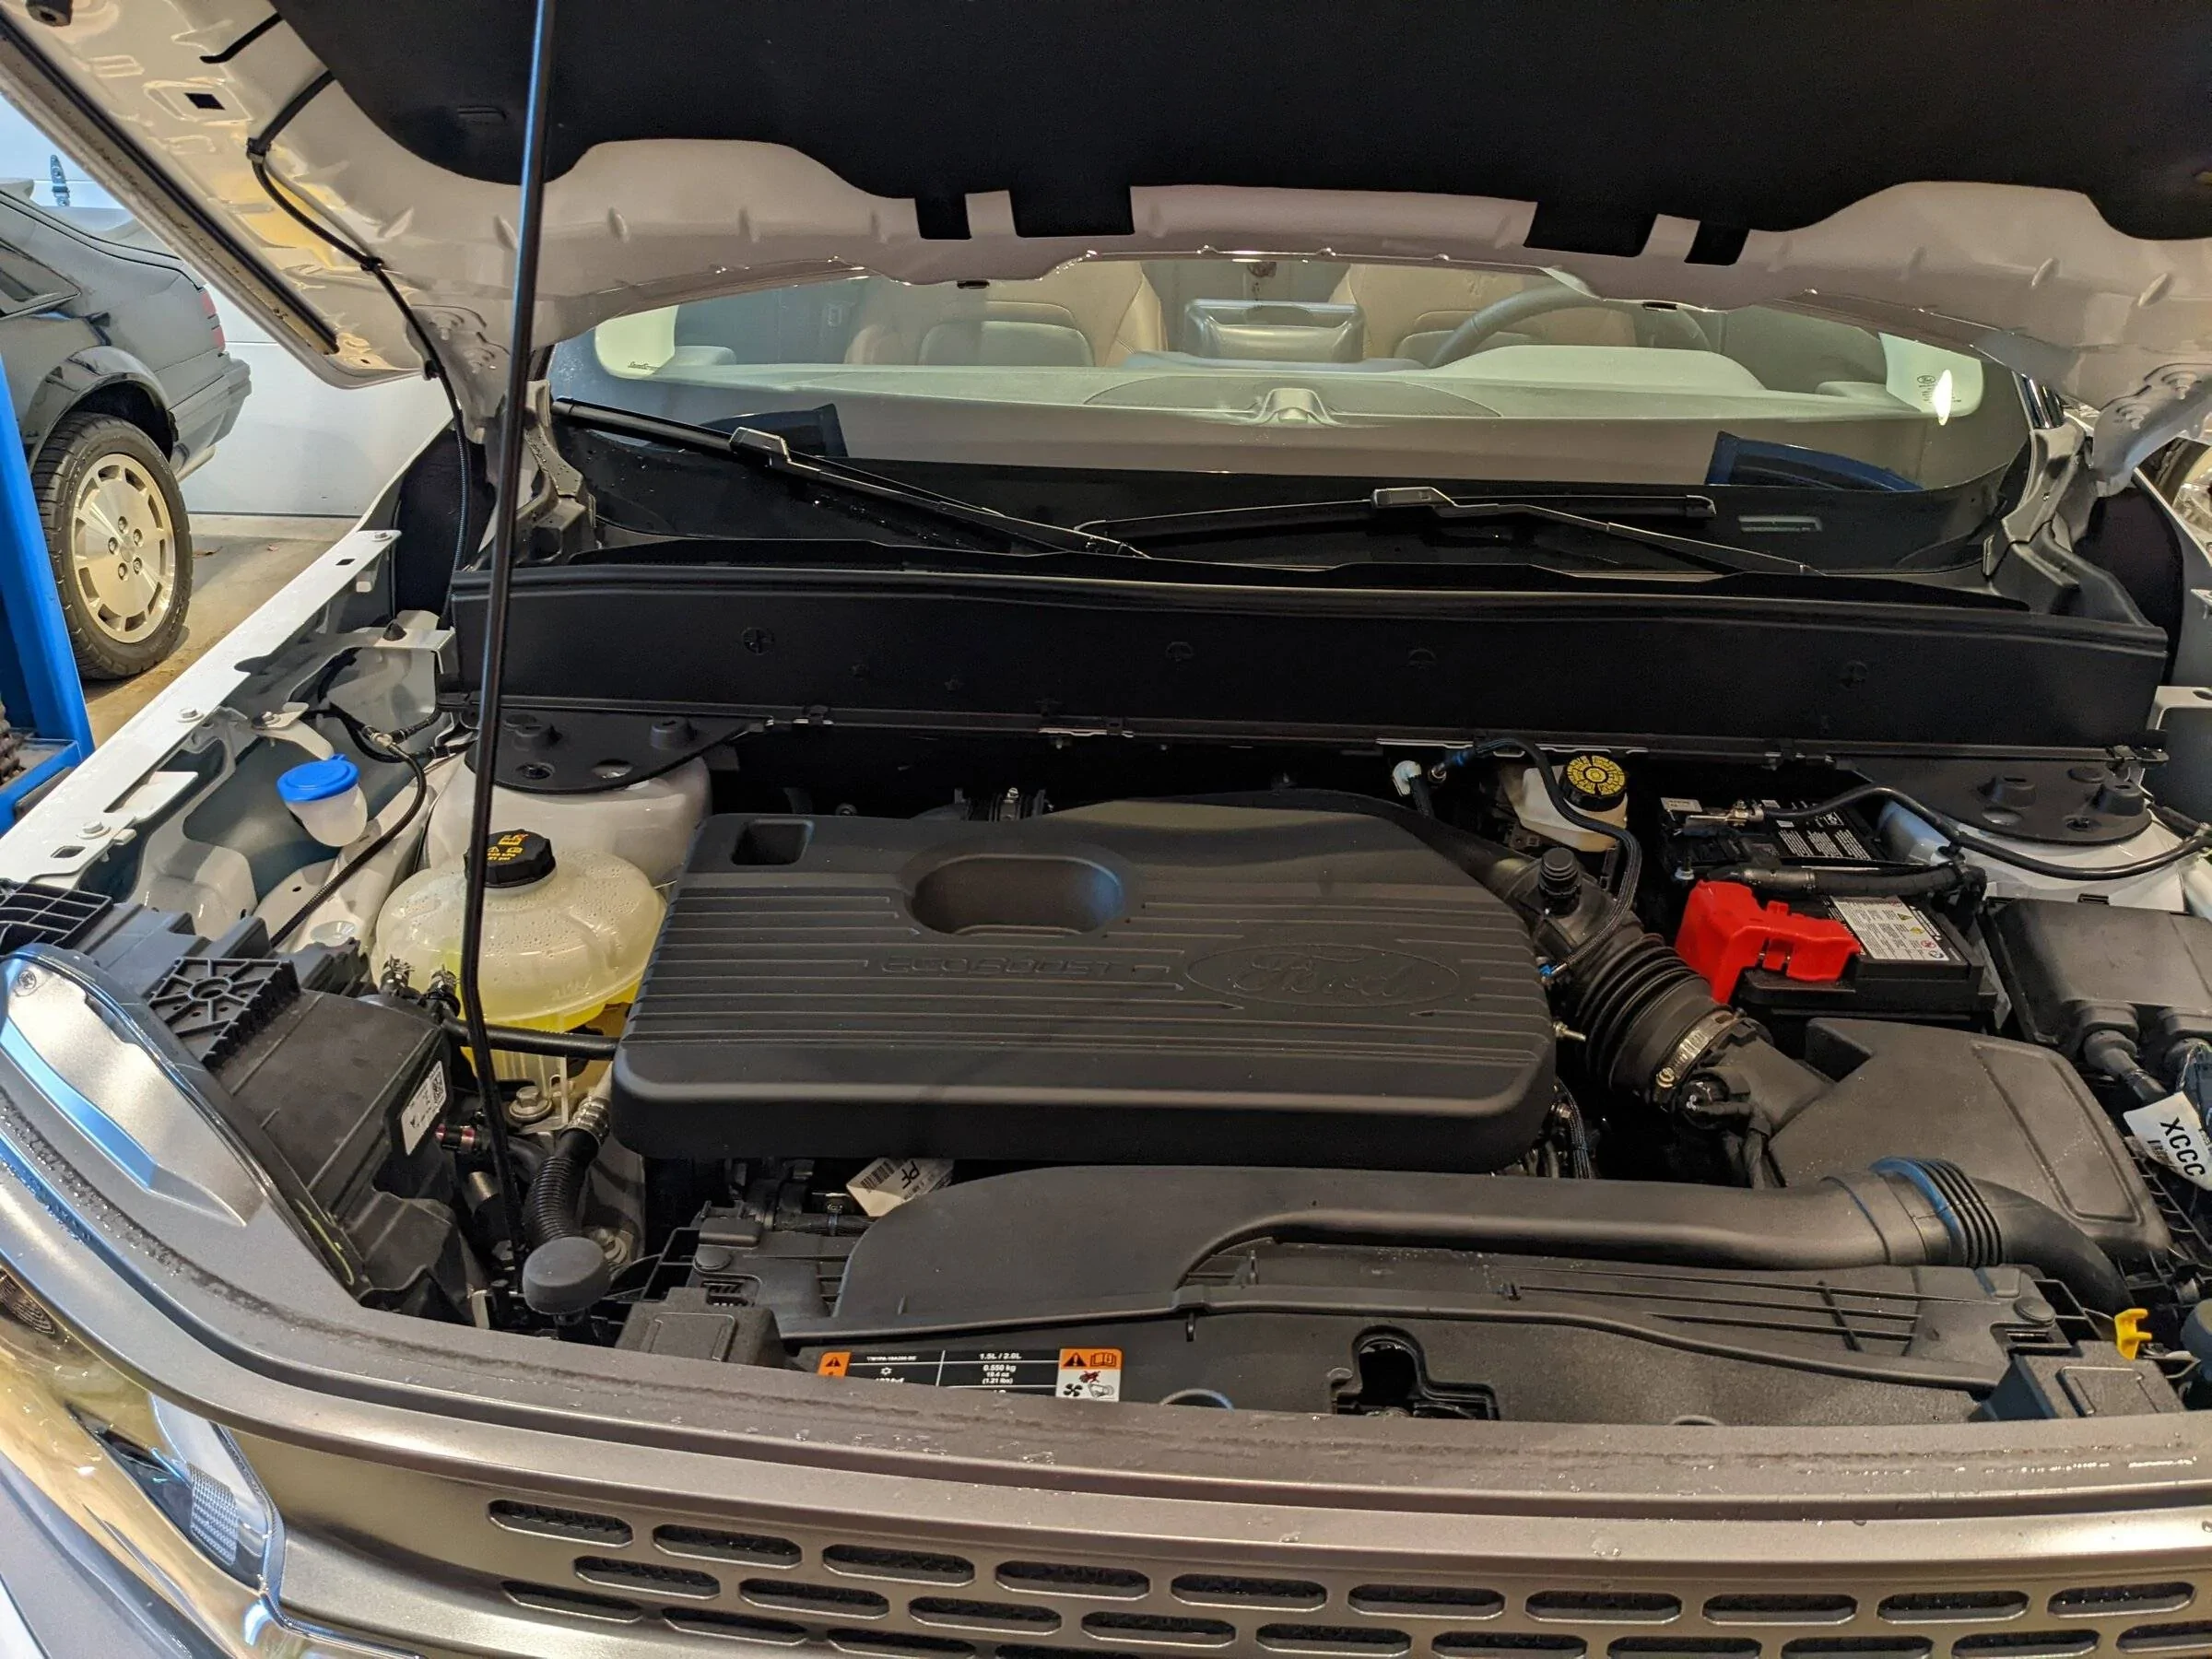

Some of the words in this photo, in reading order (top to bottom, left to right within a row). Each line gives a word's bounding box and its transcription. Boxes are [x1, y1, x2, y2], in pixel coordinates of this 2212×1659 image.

[1230, 948, 1419, 997] Ford
[2159, 1116, 2206, 1176] XCCC
[900, 1160, 921, 1190] PF
[979, 1352, 997, 1360] 1.5L
[1003, 1352, 1022, 1360] 2.0L
[1006, 1364, 1017, 1373] kg
